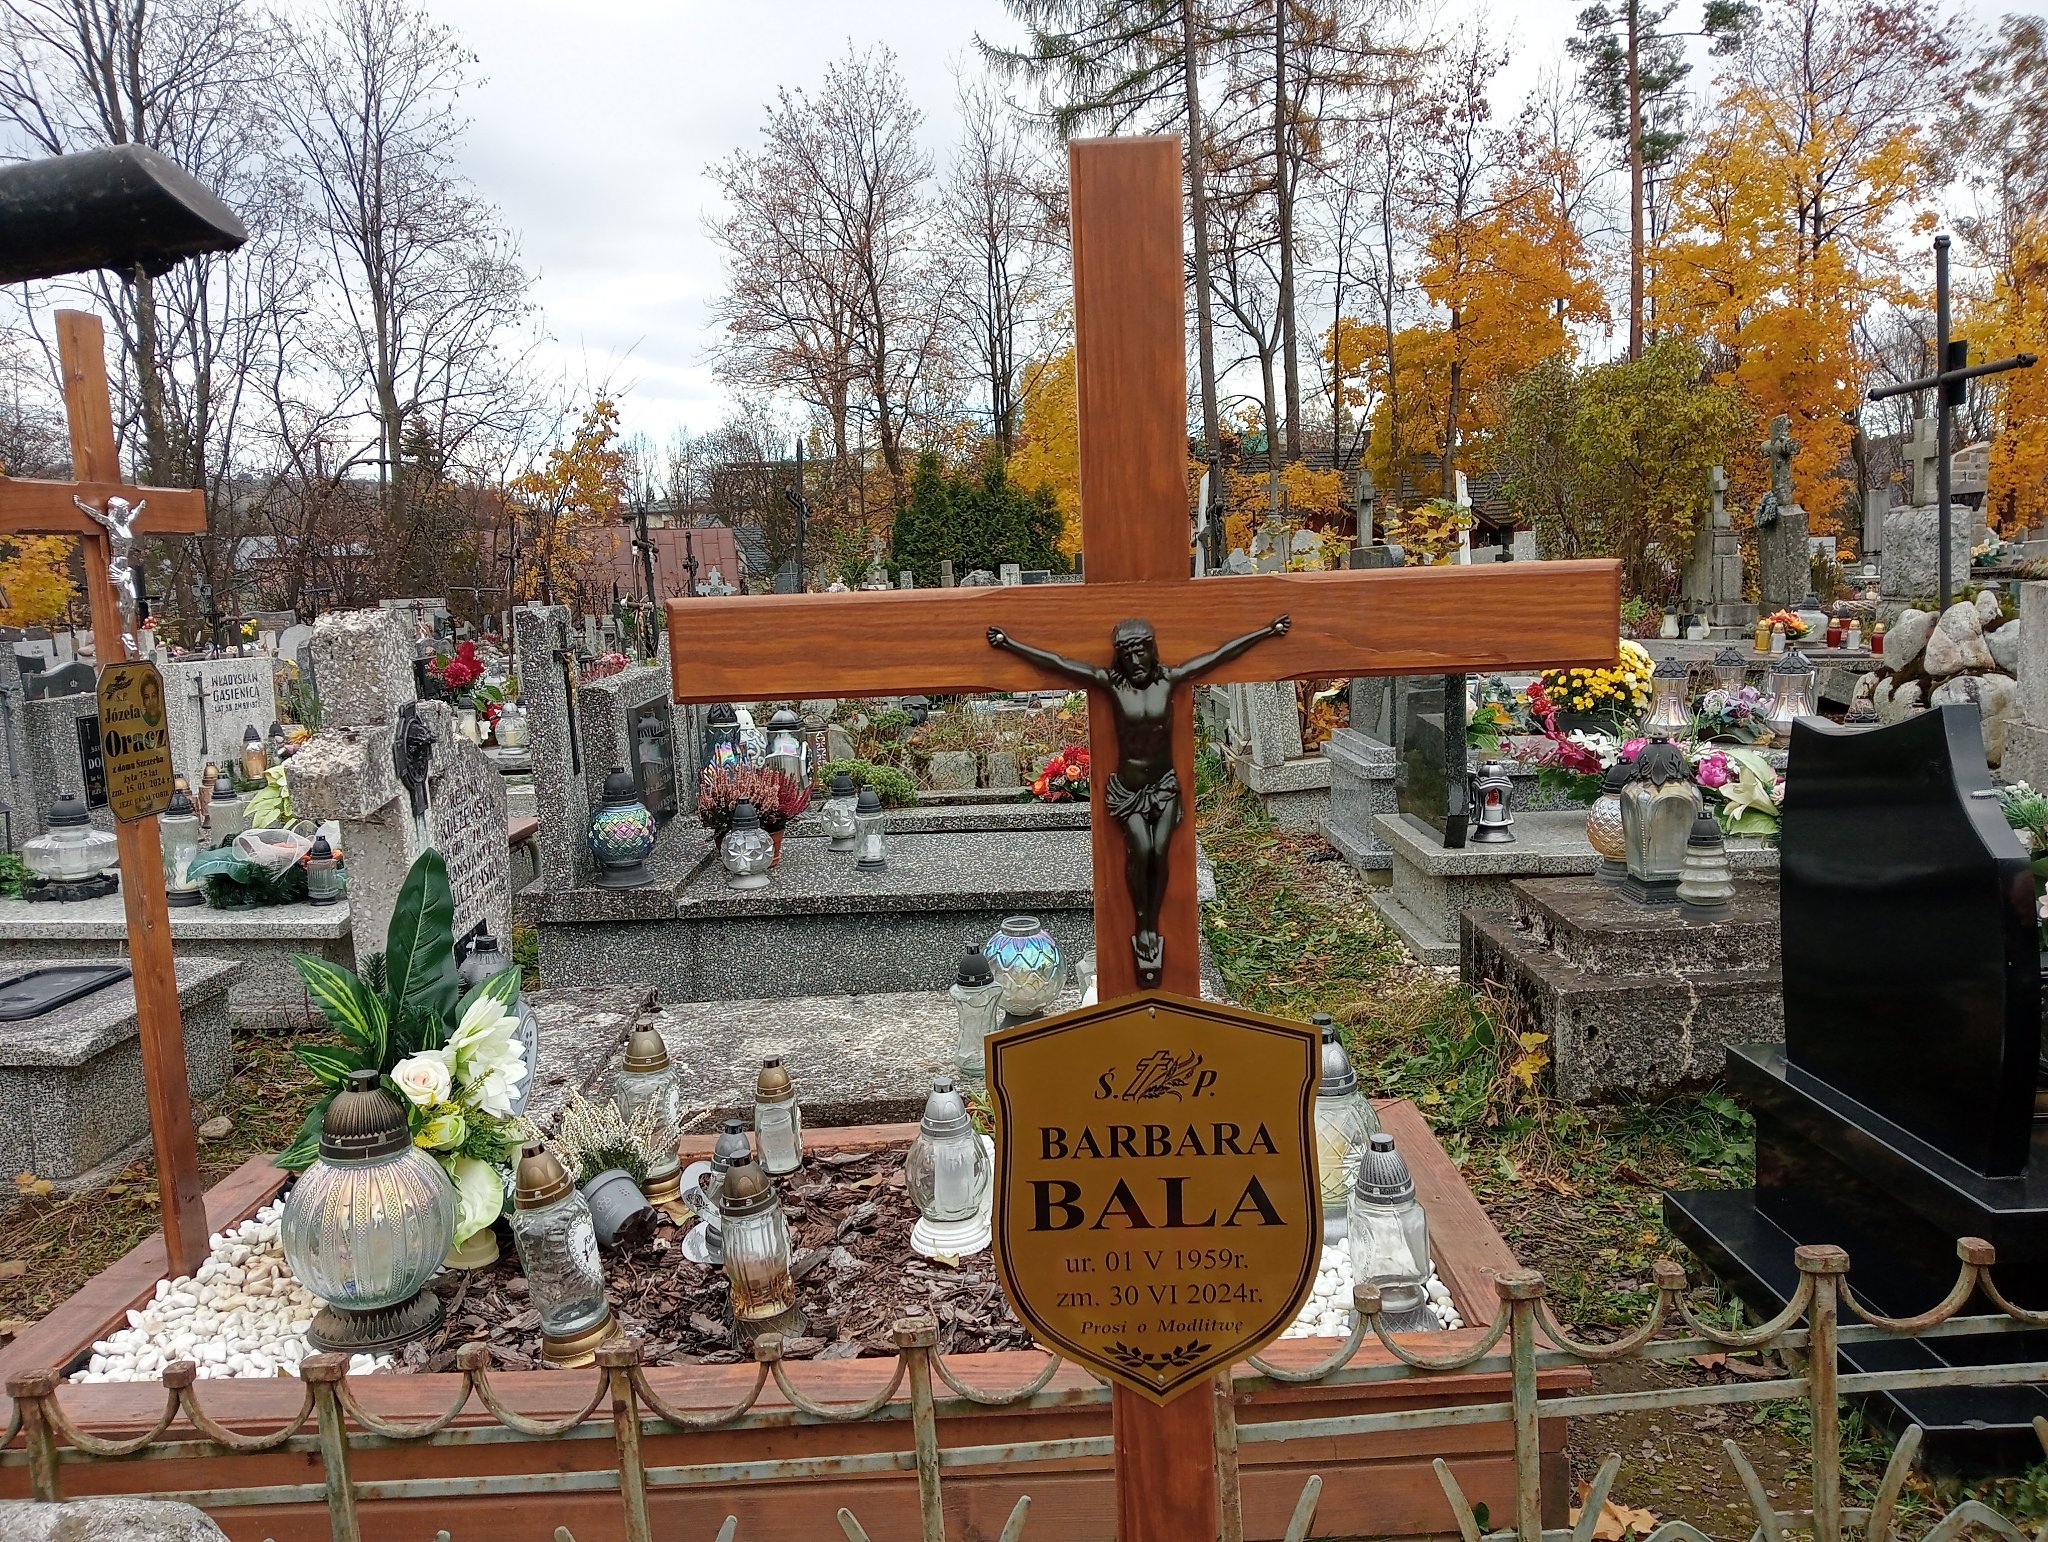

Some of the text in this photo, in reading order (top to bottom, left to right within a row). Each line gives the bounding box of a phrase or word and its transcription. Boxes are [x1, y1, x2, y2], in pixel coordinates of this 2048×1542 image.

[105, 704, 141, 723] Józefa
[105, 729, 167, 758] Oracz
[118, 761, 135, 772] domu
[139, 769, 148, 779] 75
[150, 777, 165, 788] 2024
[1192, 1069, 1218, 1098] P.
[1038, 1121, 1280, 1161] BARBARA
[1026, 1174, 1288, 1232] BALA
[1066, 1248, 1250, 1273] ur. 01 V 1959r.
[1056, 1282, 1263, 1309] zm. 30 VI 2024r.
[1080, 1317, 1244, 1336] Prosi o Modlitwę
